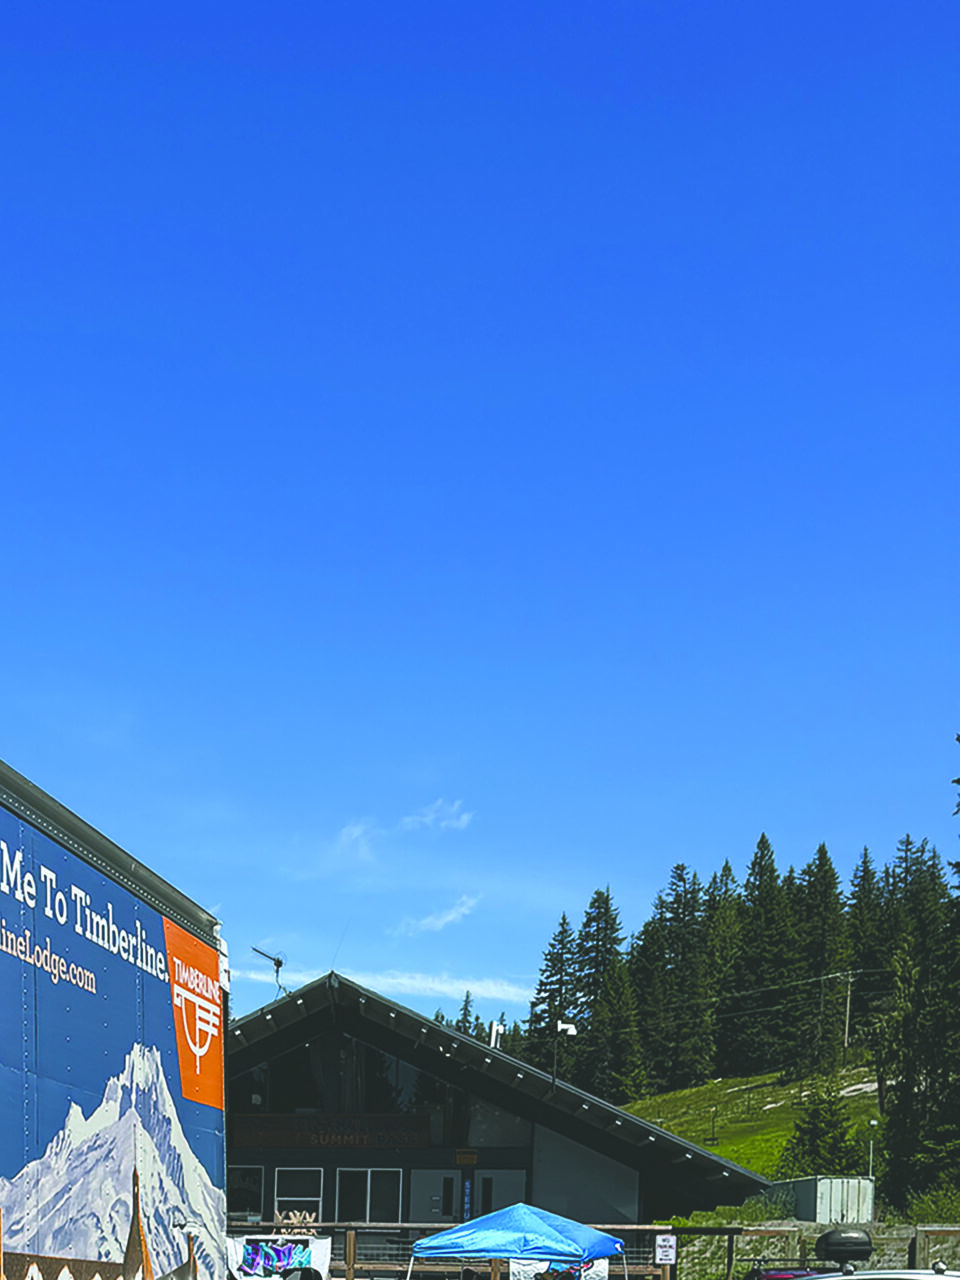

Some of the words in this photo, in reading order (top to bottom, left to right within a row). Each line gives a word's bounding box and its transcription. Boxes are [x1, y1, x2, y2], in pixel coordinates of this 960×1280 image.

[0, 839, 37, 909] Me
[40, 864, 68, 925] To
[70, 883, 170, 984] Timberline.
[172, 956, 221, 1004] TIMBERLINE
[309, 1134, 369, 1145] SUMMIT
